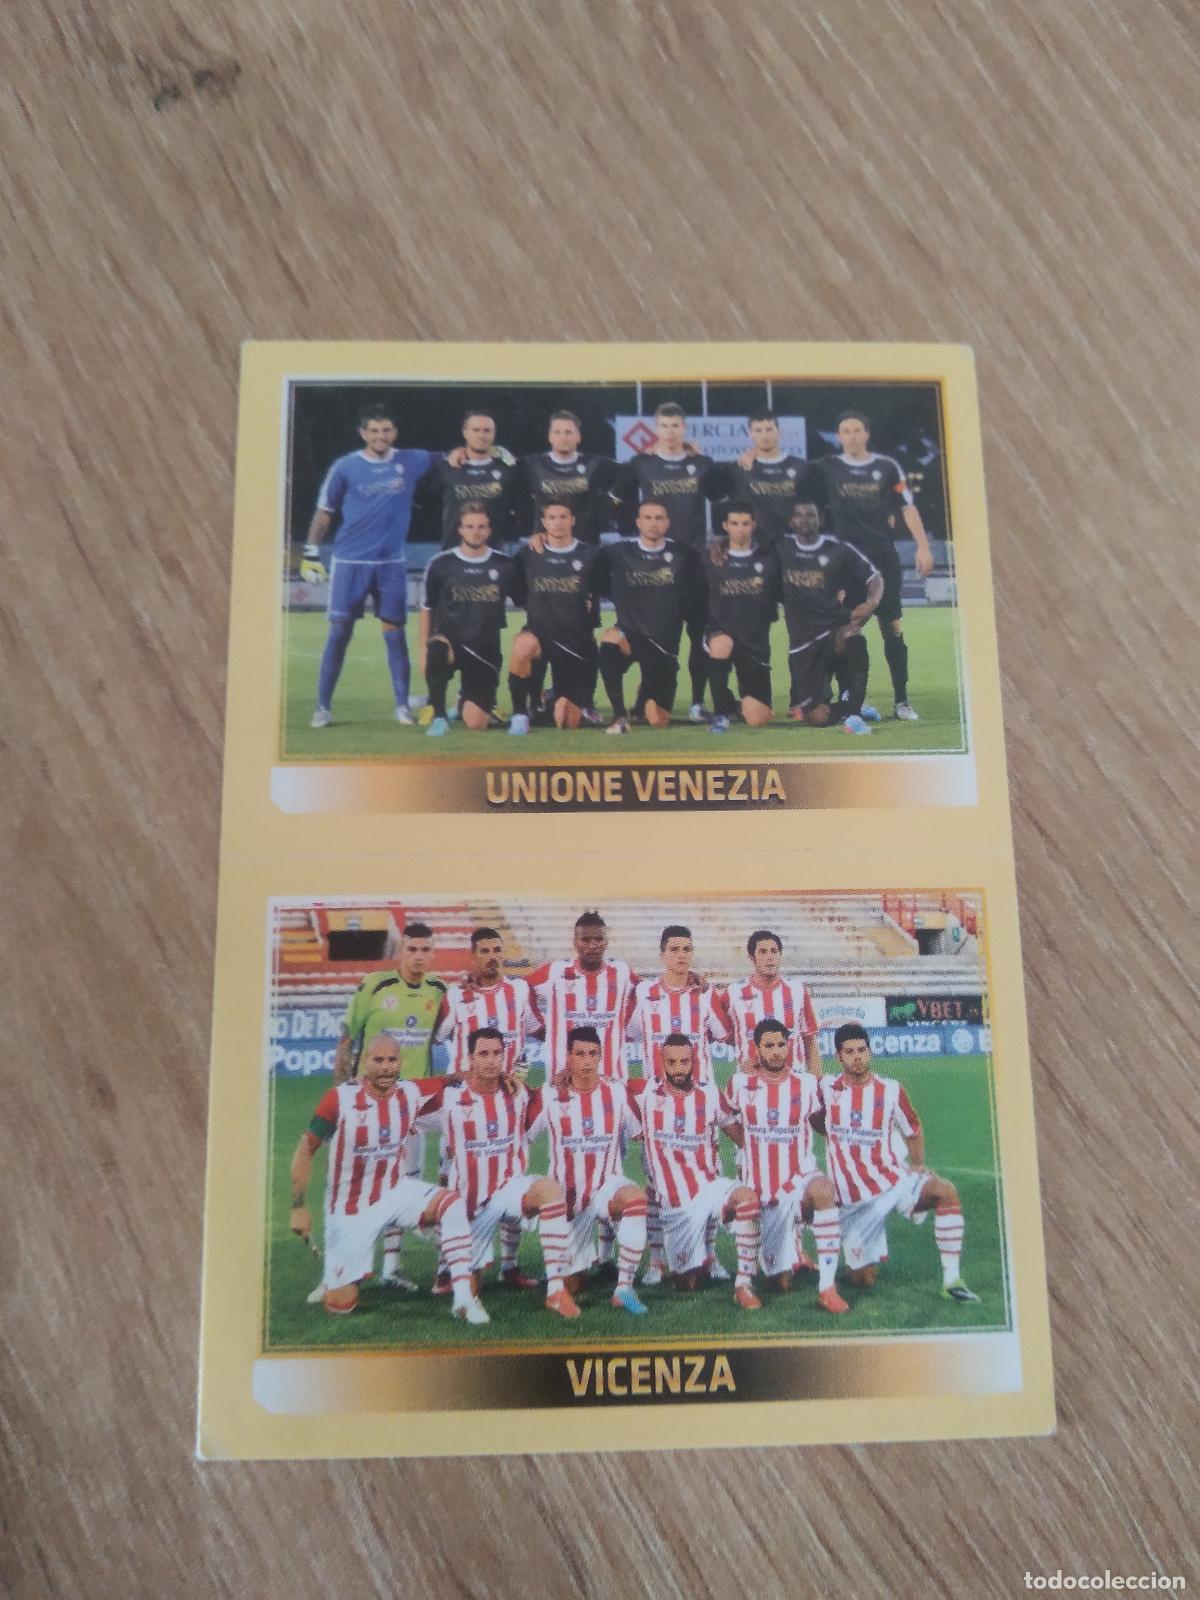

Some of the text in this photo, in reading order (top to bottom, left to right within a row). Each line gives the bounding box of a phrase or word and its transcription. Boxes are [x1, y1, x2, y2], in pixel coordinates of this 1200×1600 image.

[486, 768, 787, 804] UNIONE VENEZIA
[269, 1043, 337, 1076] Popo
[566, 1354, 737, 1397] VICENZA
